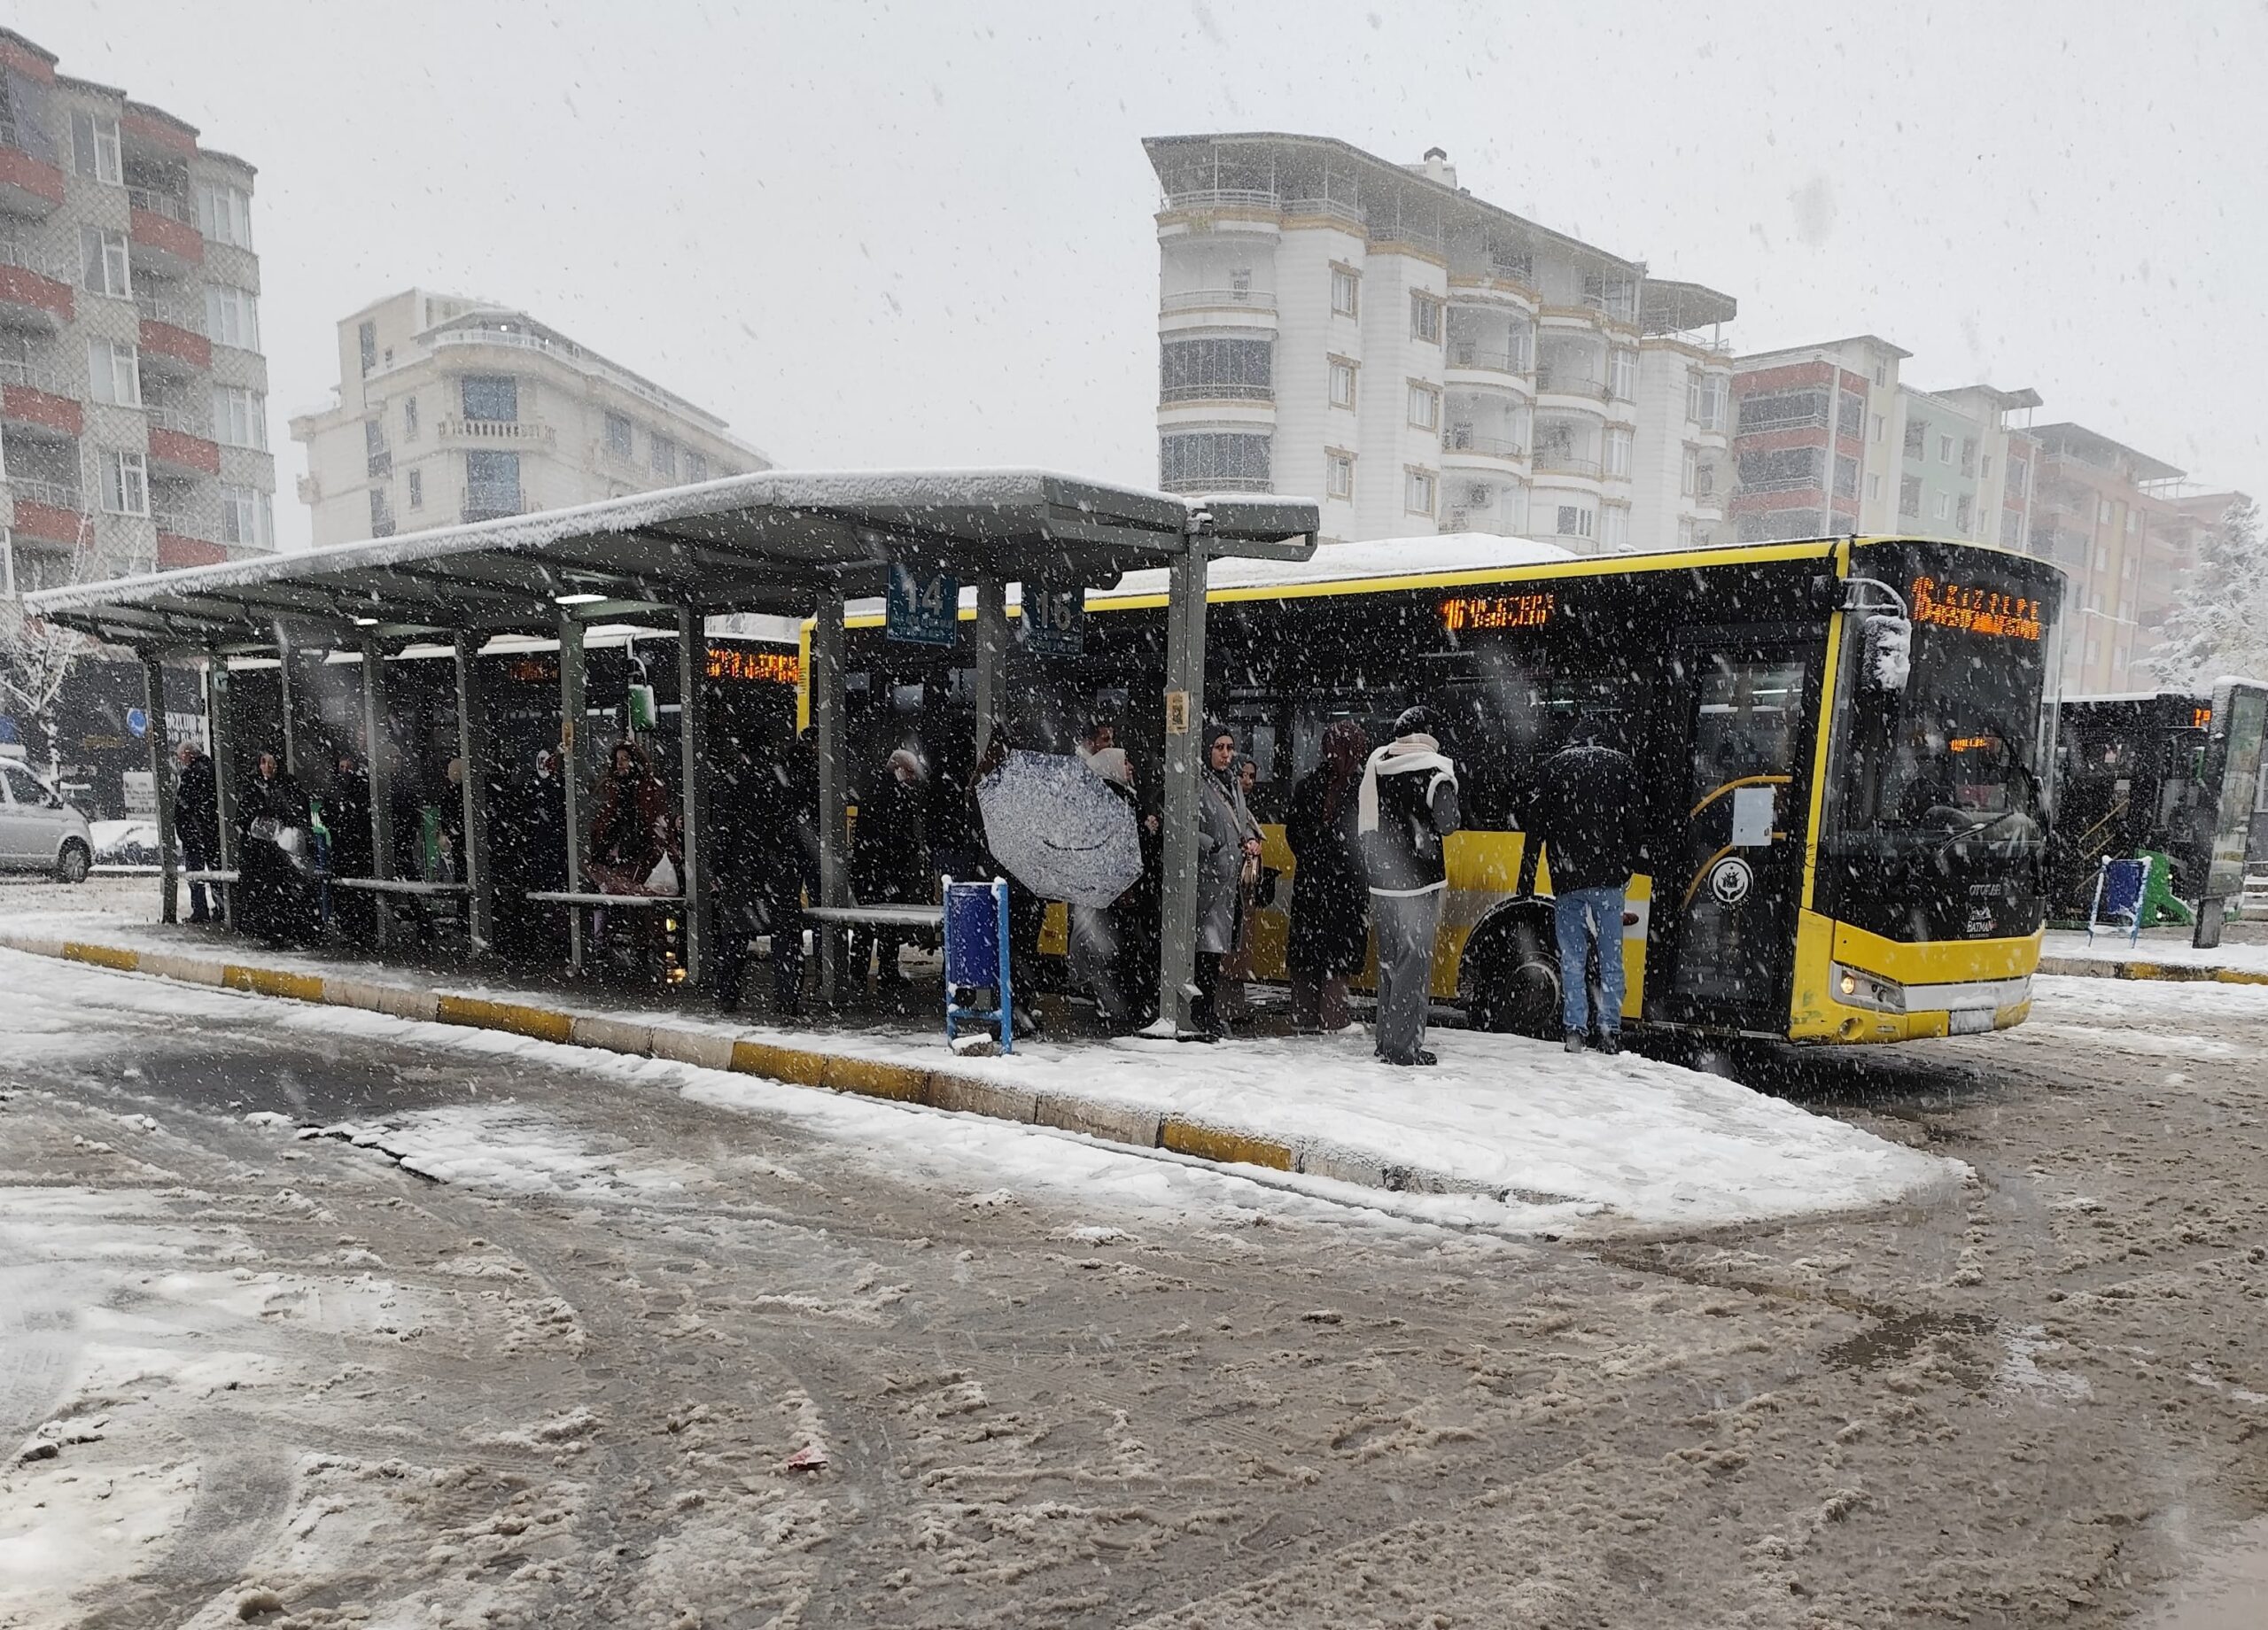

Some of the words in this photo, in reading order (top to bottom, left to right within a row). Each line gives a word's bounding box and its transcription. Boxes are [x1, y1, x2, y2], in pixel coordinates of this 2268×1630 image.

[902, 573, 943, 616] 14
[1037, 590, 1071, 631] 16
[1967, 920, 1992, 933] BATMAN
